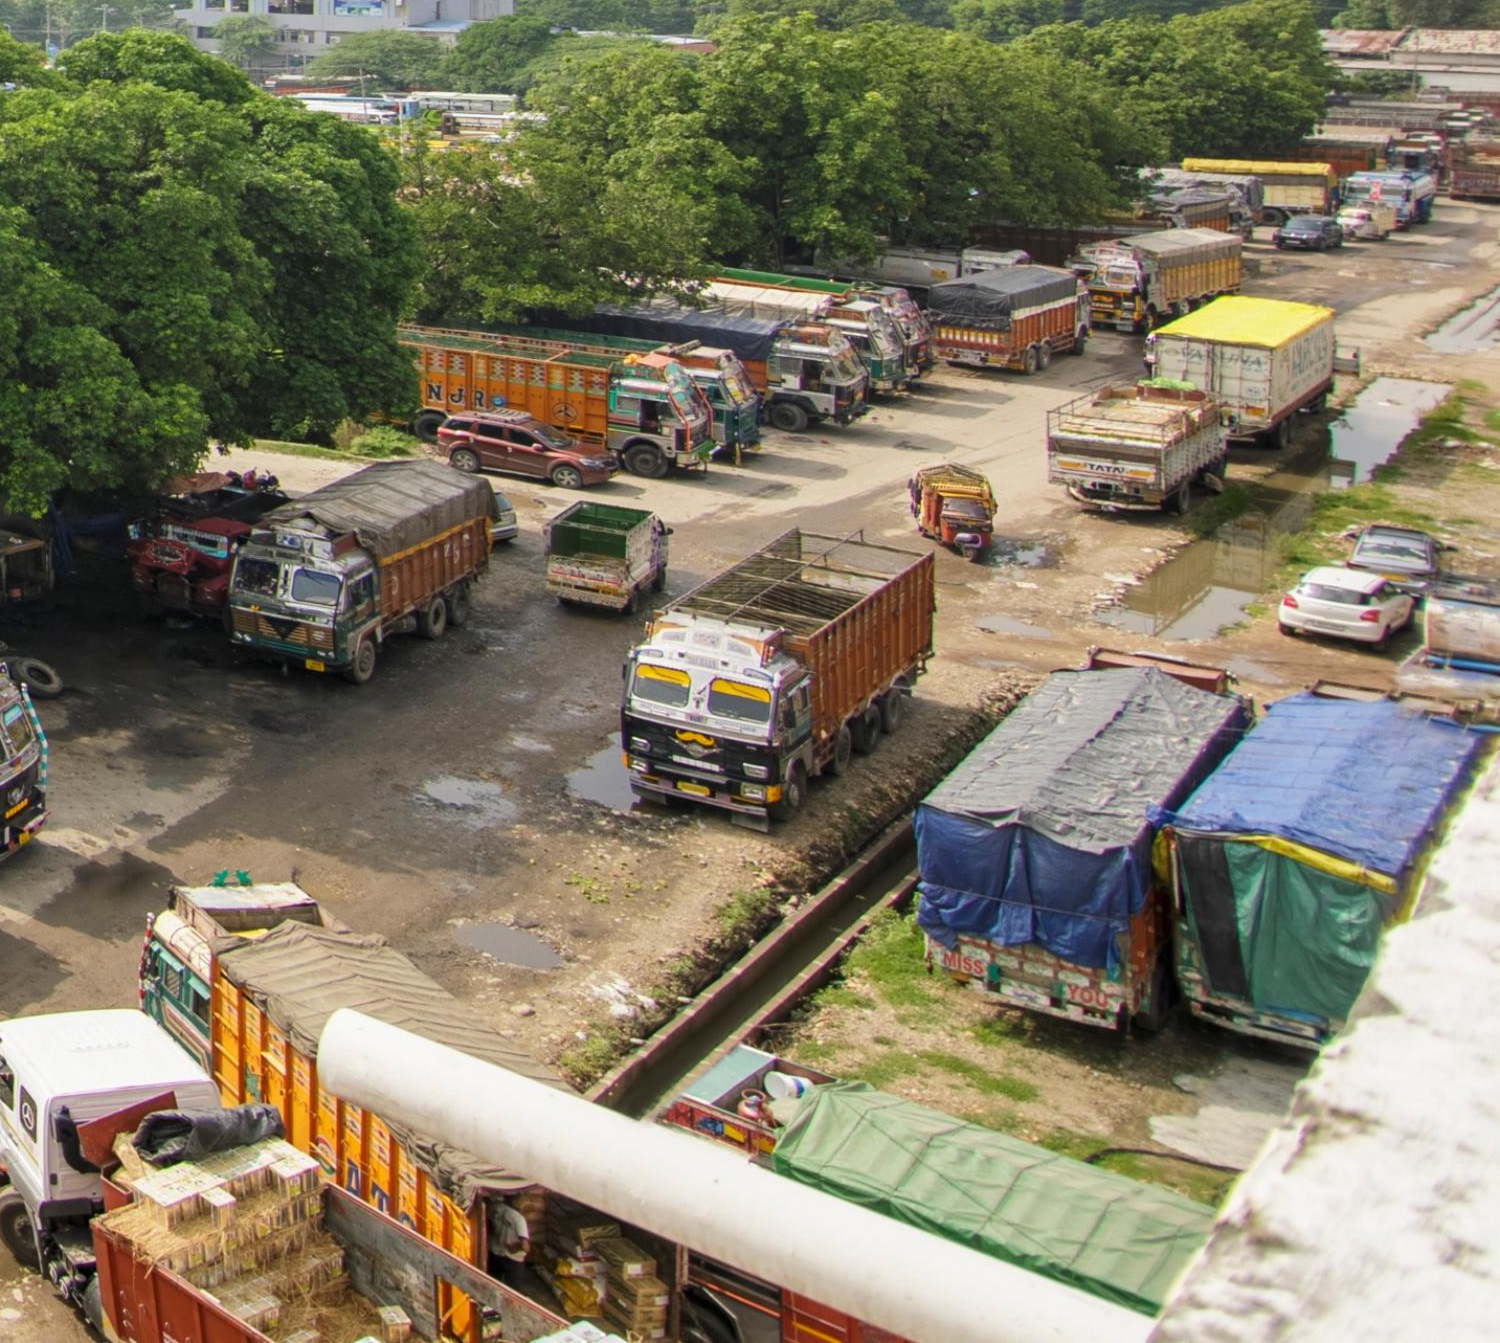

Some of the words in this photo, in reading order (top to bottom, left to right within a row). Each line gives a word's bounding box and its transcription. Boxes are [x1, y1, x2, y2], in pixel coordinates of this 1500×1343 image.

[1087, 463, 1124, 473] TATA
[942, 953, 984, 977] MISS
[1065, 984, 1111, 1008] YOU
